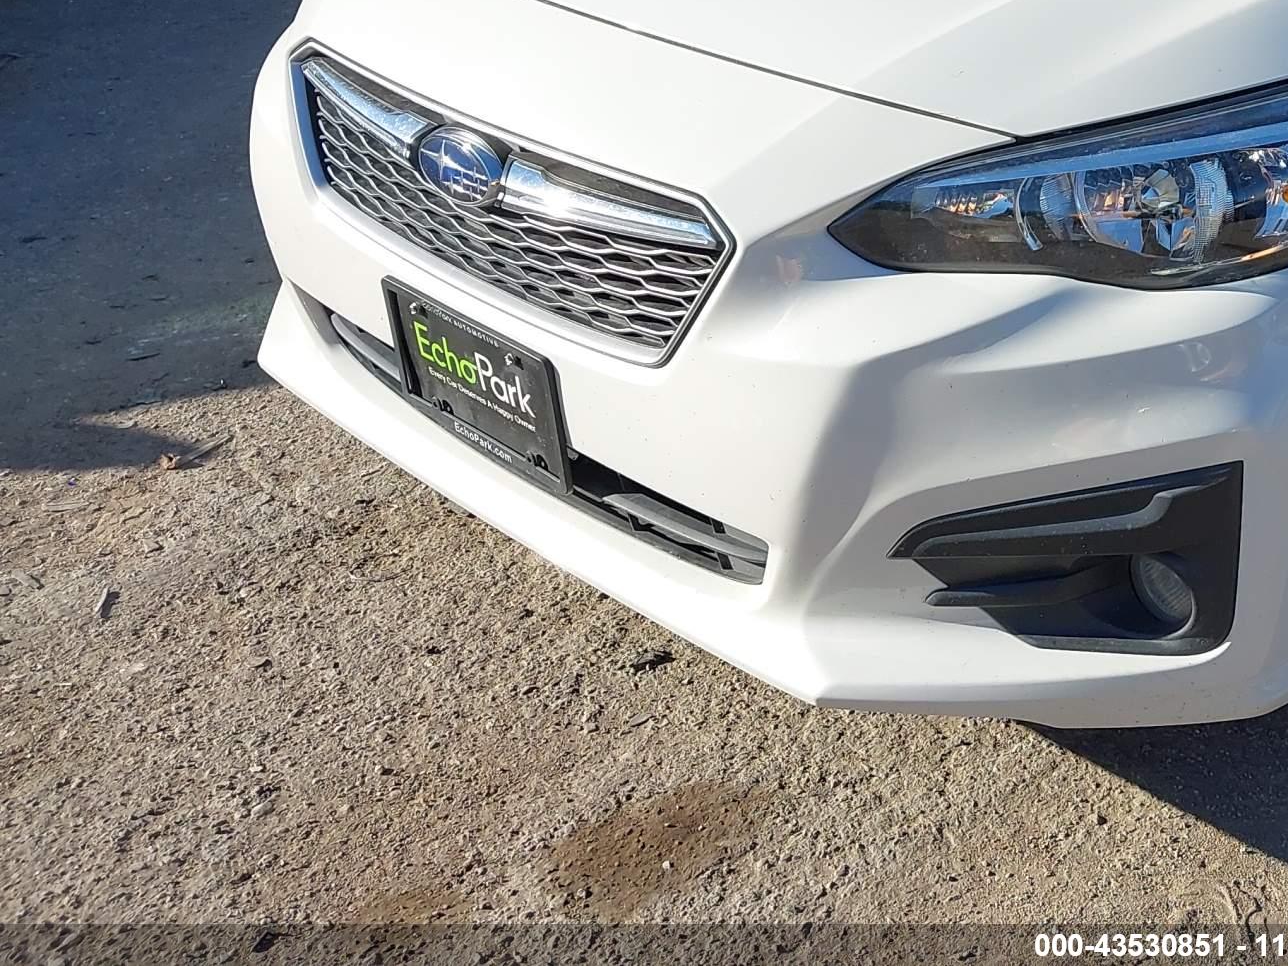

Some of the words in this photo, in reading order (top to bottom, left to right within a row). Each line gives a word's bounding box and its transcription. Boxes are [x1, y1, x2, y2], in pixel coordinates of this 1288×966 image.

[413, 321, 537, 418] EchoPark
[428, 366, 446, 384] Every
[446, 377, 457, 389] Car
[458, 384, 487, 405] Deserves
[493, 403, 514, 421] Happy
[454, 421, 513, 464] EchoPark.com
